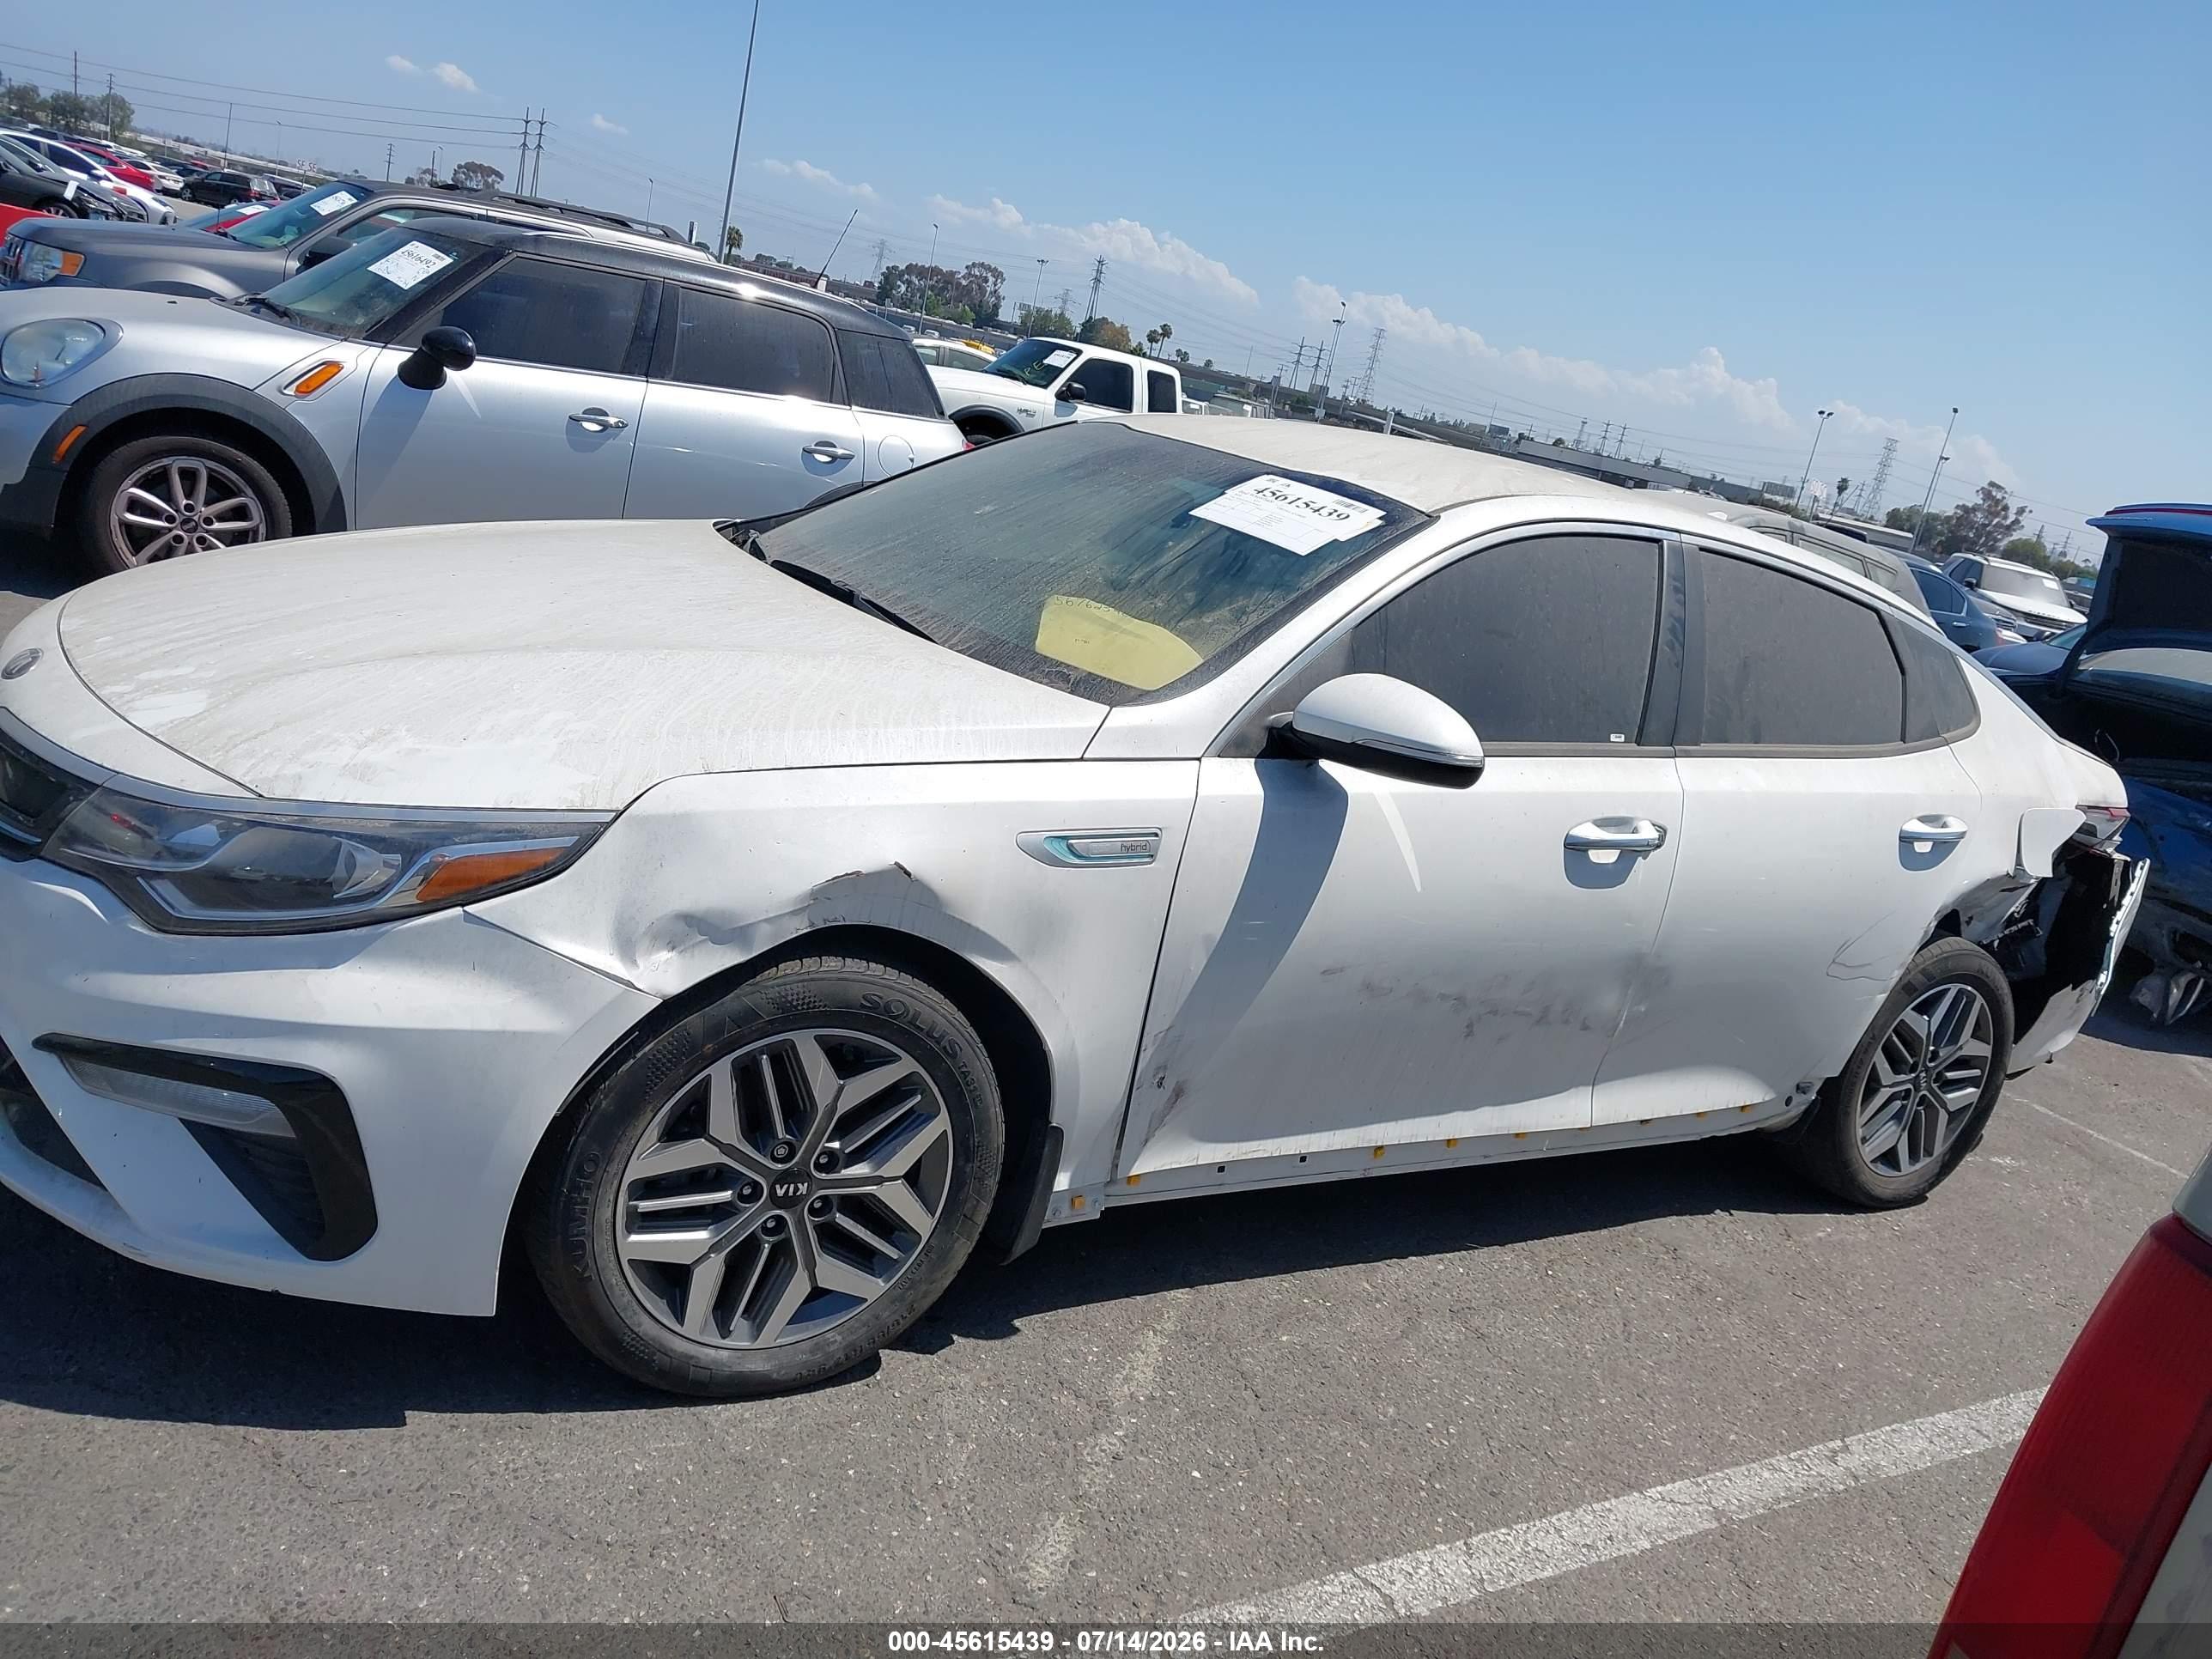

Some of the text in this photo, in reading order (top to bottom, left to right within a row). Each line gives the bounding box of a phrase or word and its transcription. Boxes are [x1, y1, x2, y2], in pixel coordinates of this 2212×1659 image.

[1253, 487, 1351, 521] 45615439
[1120, 842, 1148, 854] hybrid
[860, 991, 963, 1060] SOLUS
[775, 1182, 809, 1197] KIA
[568, 1151, 602, 1280] KUMHO
